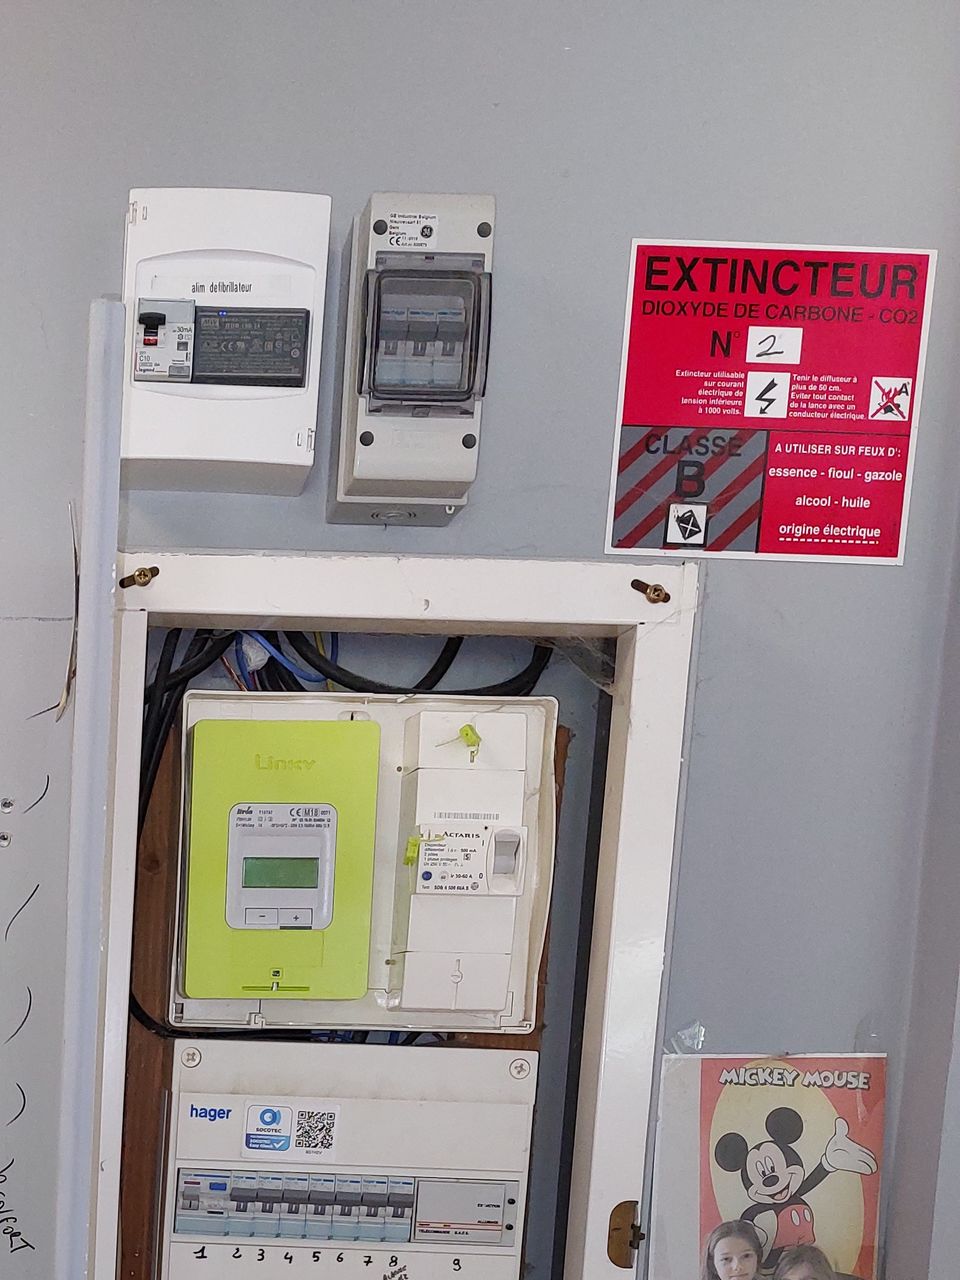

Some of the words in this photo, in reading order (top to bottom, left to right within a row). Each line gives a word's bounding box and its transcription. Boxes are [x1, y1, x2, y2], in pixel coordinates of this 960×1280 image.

[645, 256, 918, 299] EXTINCTEUR
[191, 281, 206, 293] alim
[642, 300, 728, 318] DIOXYDE
[734, 303, 760, 319] DE
[765, 303, 864, 322] CARBONE
[879, 308, 918, 325] CO2
[756, 335, 784, 358] 2
[675, 369, 712, 378] Extincteur
[713, 371, 745, 379] utilisable
[811, 374, 819, 382] le
[820, 375, 851, 383] diffuseur
[697, 388, 733, 398] électrique
[791, 383, 807, 392] plus
[681, 397, 708, 405] tension
[709, 398, 743, 406] inférieure
[790, 392, 811, 400] Eviter
[788, 411, 829, 419] conducteur
[645, 433, 742, 457] CLASSE
[774, 443, 782, 453] A
[785, 443, 832, 455] UTILISER
[834, 445, 856, 455] SUR
[858, 446, 885, 457] FEUX
[675, 460, 706, 498] B
[768, 467, 818, 478] essence
[828, 467, 854, 479] fioul
[864, 470, 903, 482] gazole
[795, 495, 831, 507] alcool
[841, 496, 871, 508] huile
[779, 523, 820, 537] origine
[823, 524, 881, 540] électrique
[719, 1066, 800, 1086] MICKEY
[801, 1069, 871, 1090] MOUSE
[190, 1104, 232, 1121] hager
[193, 1246, 208, 1259] 1
[232, 1247, 242, 1259] 2
[257, 1248, 265, 1261] 3
[284, 1252, 293, 1264] 4
[312, 1251, 322, 1262] 5
[336, 1252, 344, 1263] 6
[363, 1255, 373, 1267] 7
[388, 1255, 399, 1268] 8
[452, 1258, 462, 1271] 9
